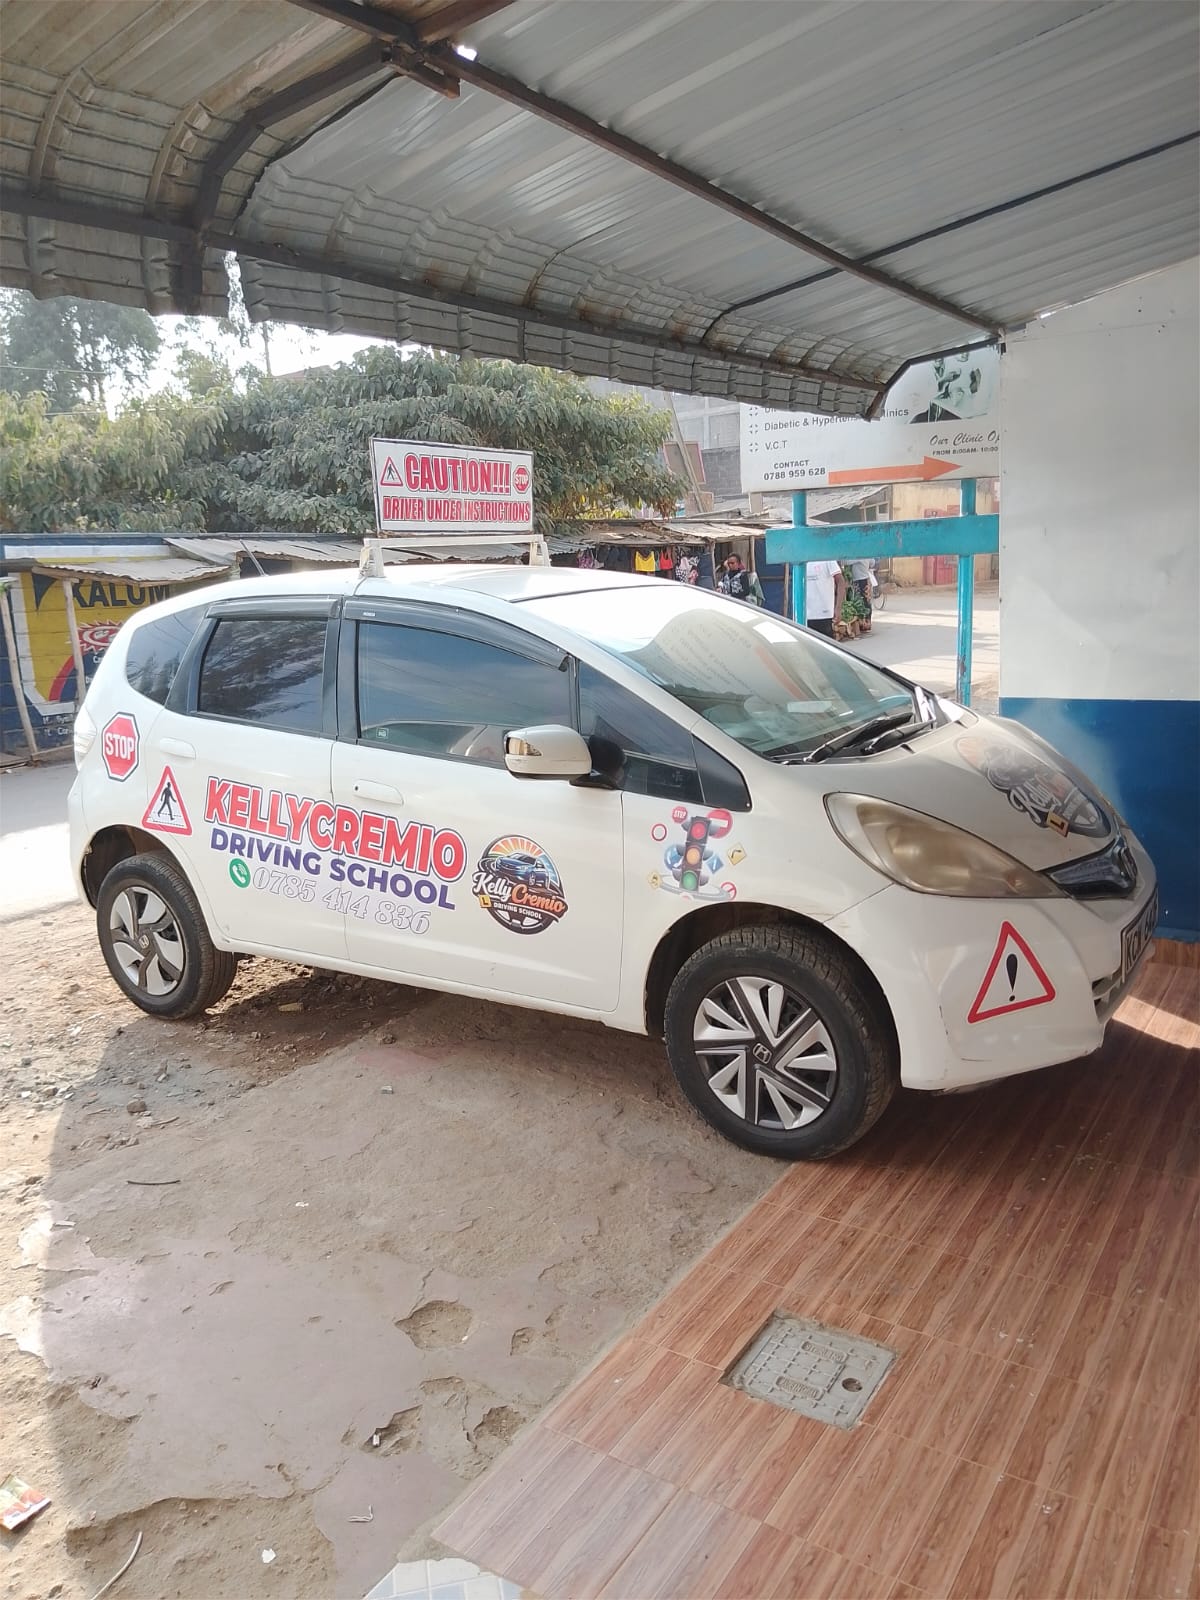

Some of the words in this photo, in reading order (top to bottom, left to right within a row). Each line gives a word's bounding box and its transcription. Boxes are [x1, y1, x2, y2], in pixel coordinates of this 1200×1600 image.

[764, 420, 800, 431] Diabetic
[802, 418, 809, 426] &
[884, 408, 909, 418] linics
[765, 440, 788, 450] V.C.T
[929, 434, 949, 446] Our
[953, 432, 984, 446] Clinic
[404, 453, 511, 495] CAUTION!!!
[763, 471, 786, 481] 0788
[788, 469, 806, 478] 959
[808, 467, 826, 476] 628
[773, 459, 809, 469] CONTACT
[514, 474, 528, 485] STOP
[382, 496, 425, 521] DRIVER
[426, 498, 462, 521] UNDER
[463, 500, 531, 523] INSTRUCTIONS
[105, 732, 135, 760] STOP
[673, 810, 687, 819] STOP
[204, 776, 467, 882] KELLYCREMIO
[210, 828, 321, 875] DRIVING
[329, 860, 456, 910] SCHOOL
[253, 866, 318, 903] 0785
[323, 887, 370, 919] 414
[374, 901, 432, 935] 836
[472, 872, 512, 902] Kelly
[511, 884, 565, 913] Cremio
[482, 896, 491, 906] L
[493, 902, 518, 913] DRIVING
[518, 907, 543, 920] SCHOOL
